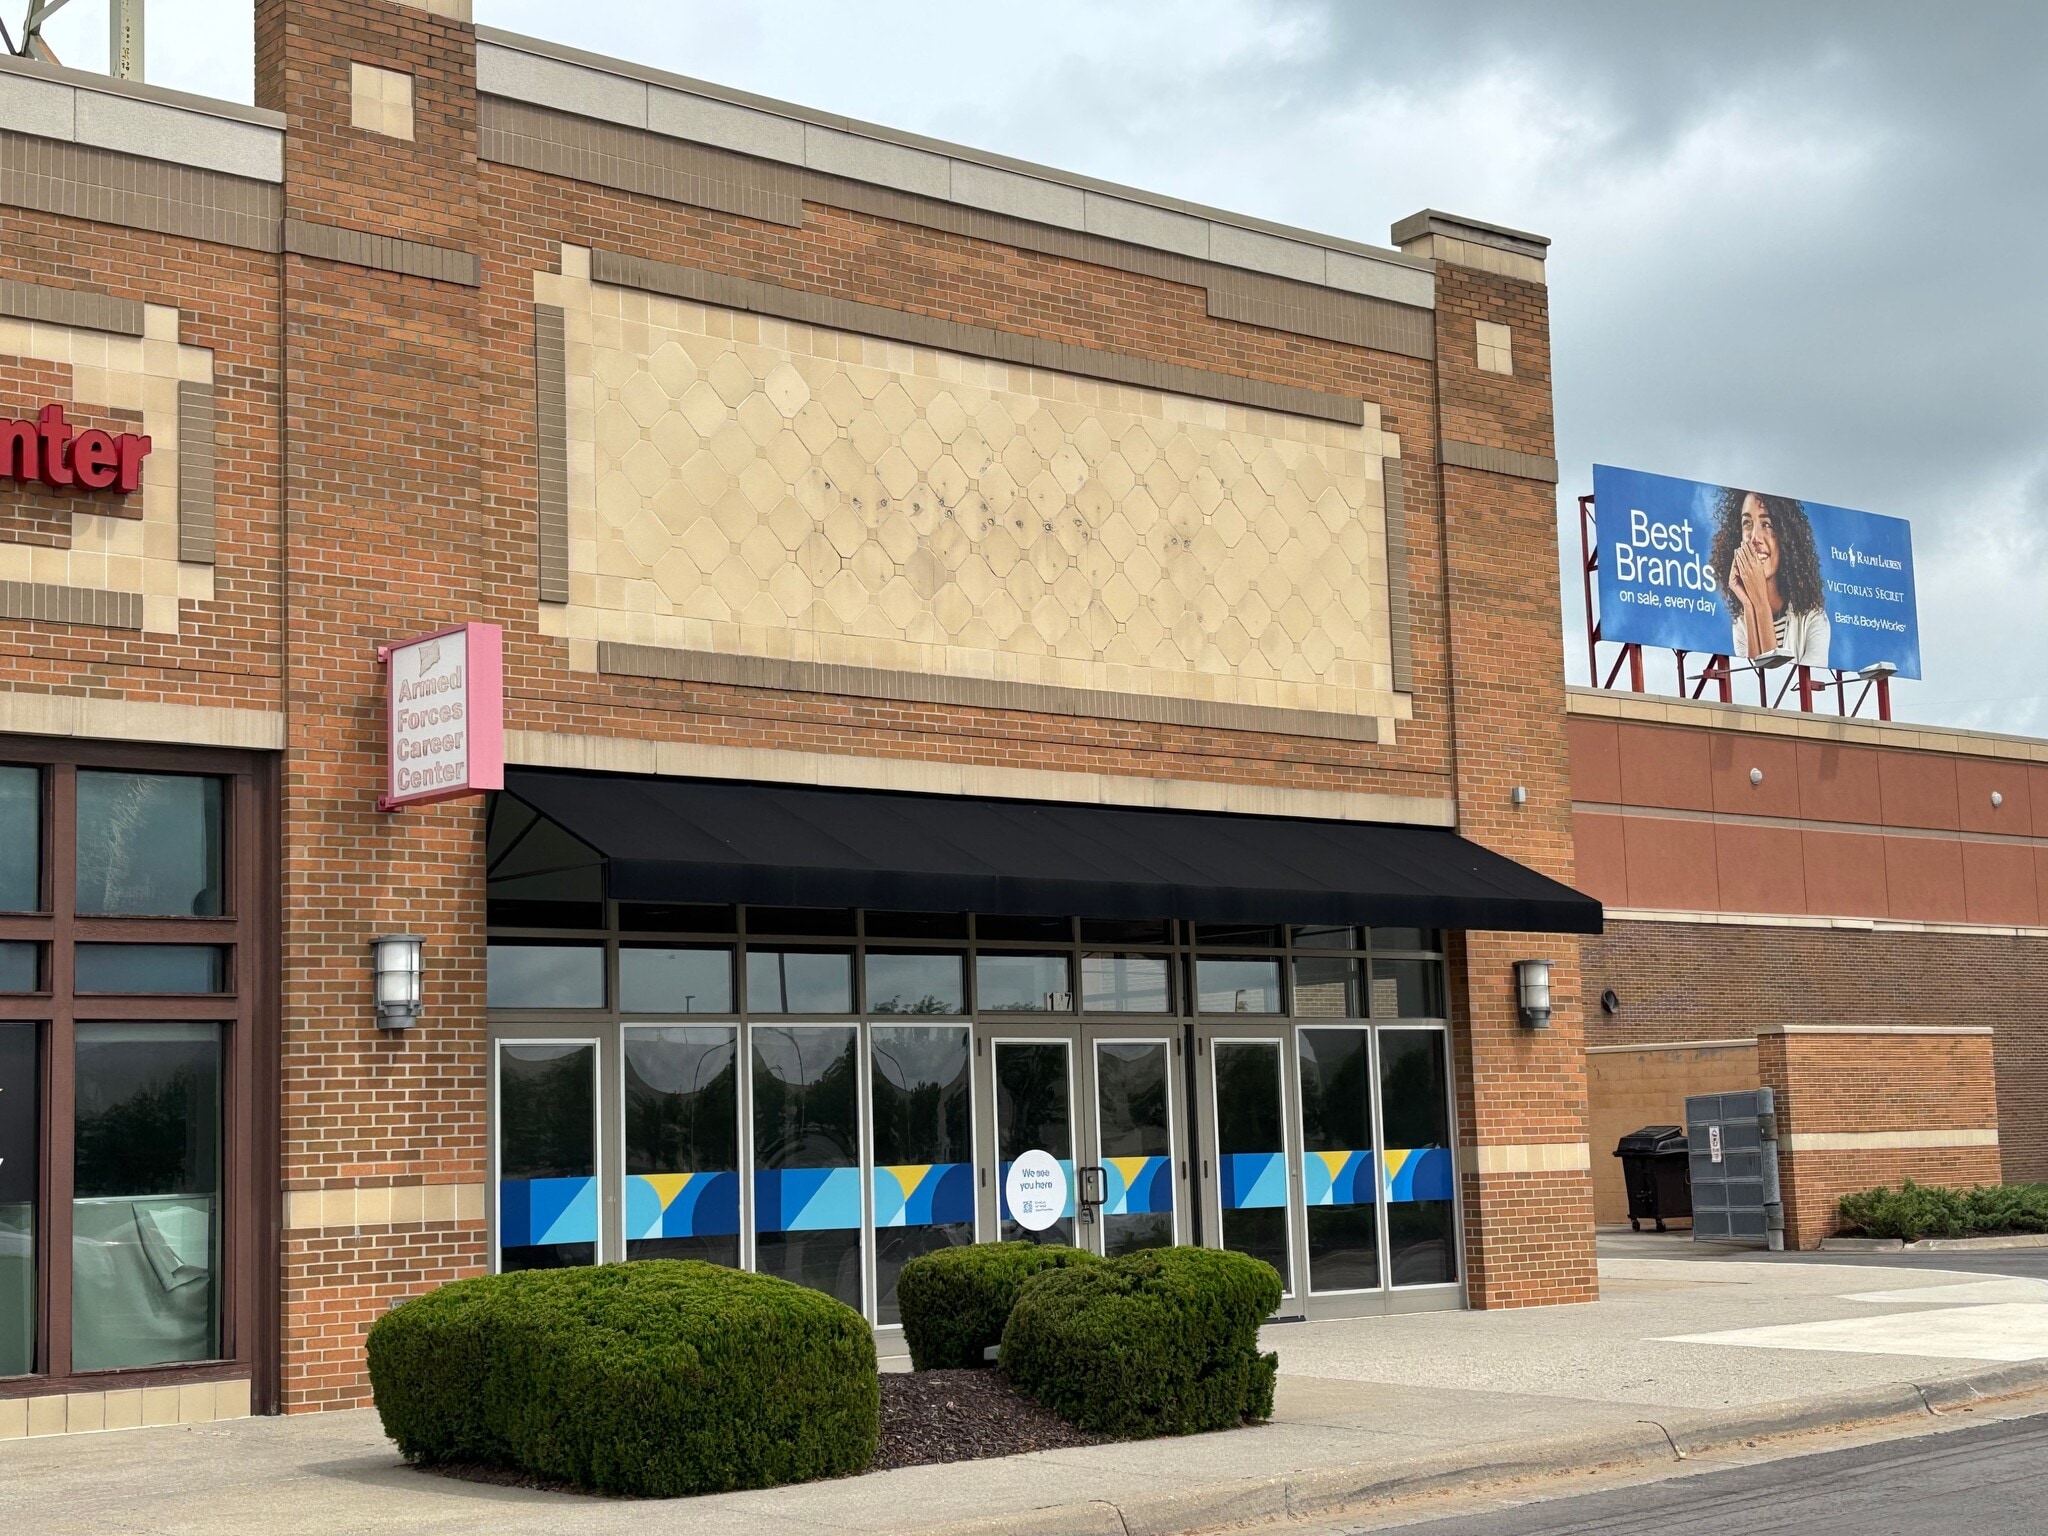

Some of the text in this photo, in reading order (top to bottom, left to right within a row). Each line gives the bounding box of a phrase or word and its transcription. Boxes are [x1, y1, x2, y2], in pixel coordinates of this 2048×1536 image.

[0, 404, 152, 494] nter
[1630, 509, 1695, 555] Best
[1615, 542, 1717, 593] Brands
[1619, 590, 1717, 616] on sale, every day
[1853, 614, 1860, 626] &
[1860, 616, 1880, 631] Body
[398, 665, 462, 703] Armed
[397, 702, 464, 733] Forces
[397, 731, 464, 761] Career
[397, 760, 465, 790] Center
[1019, 1182, 1035, 1192] you
[1022, 1168, 1036, 1178] We
